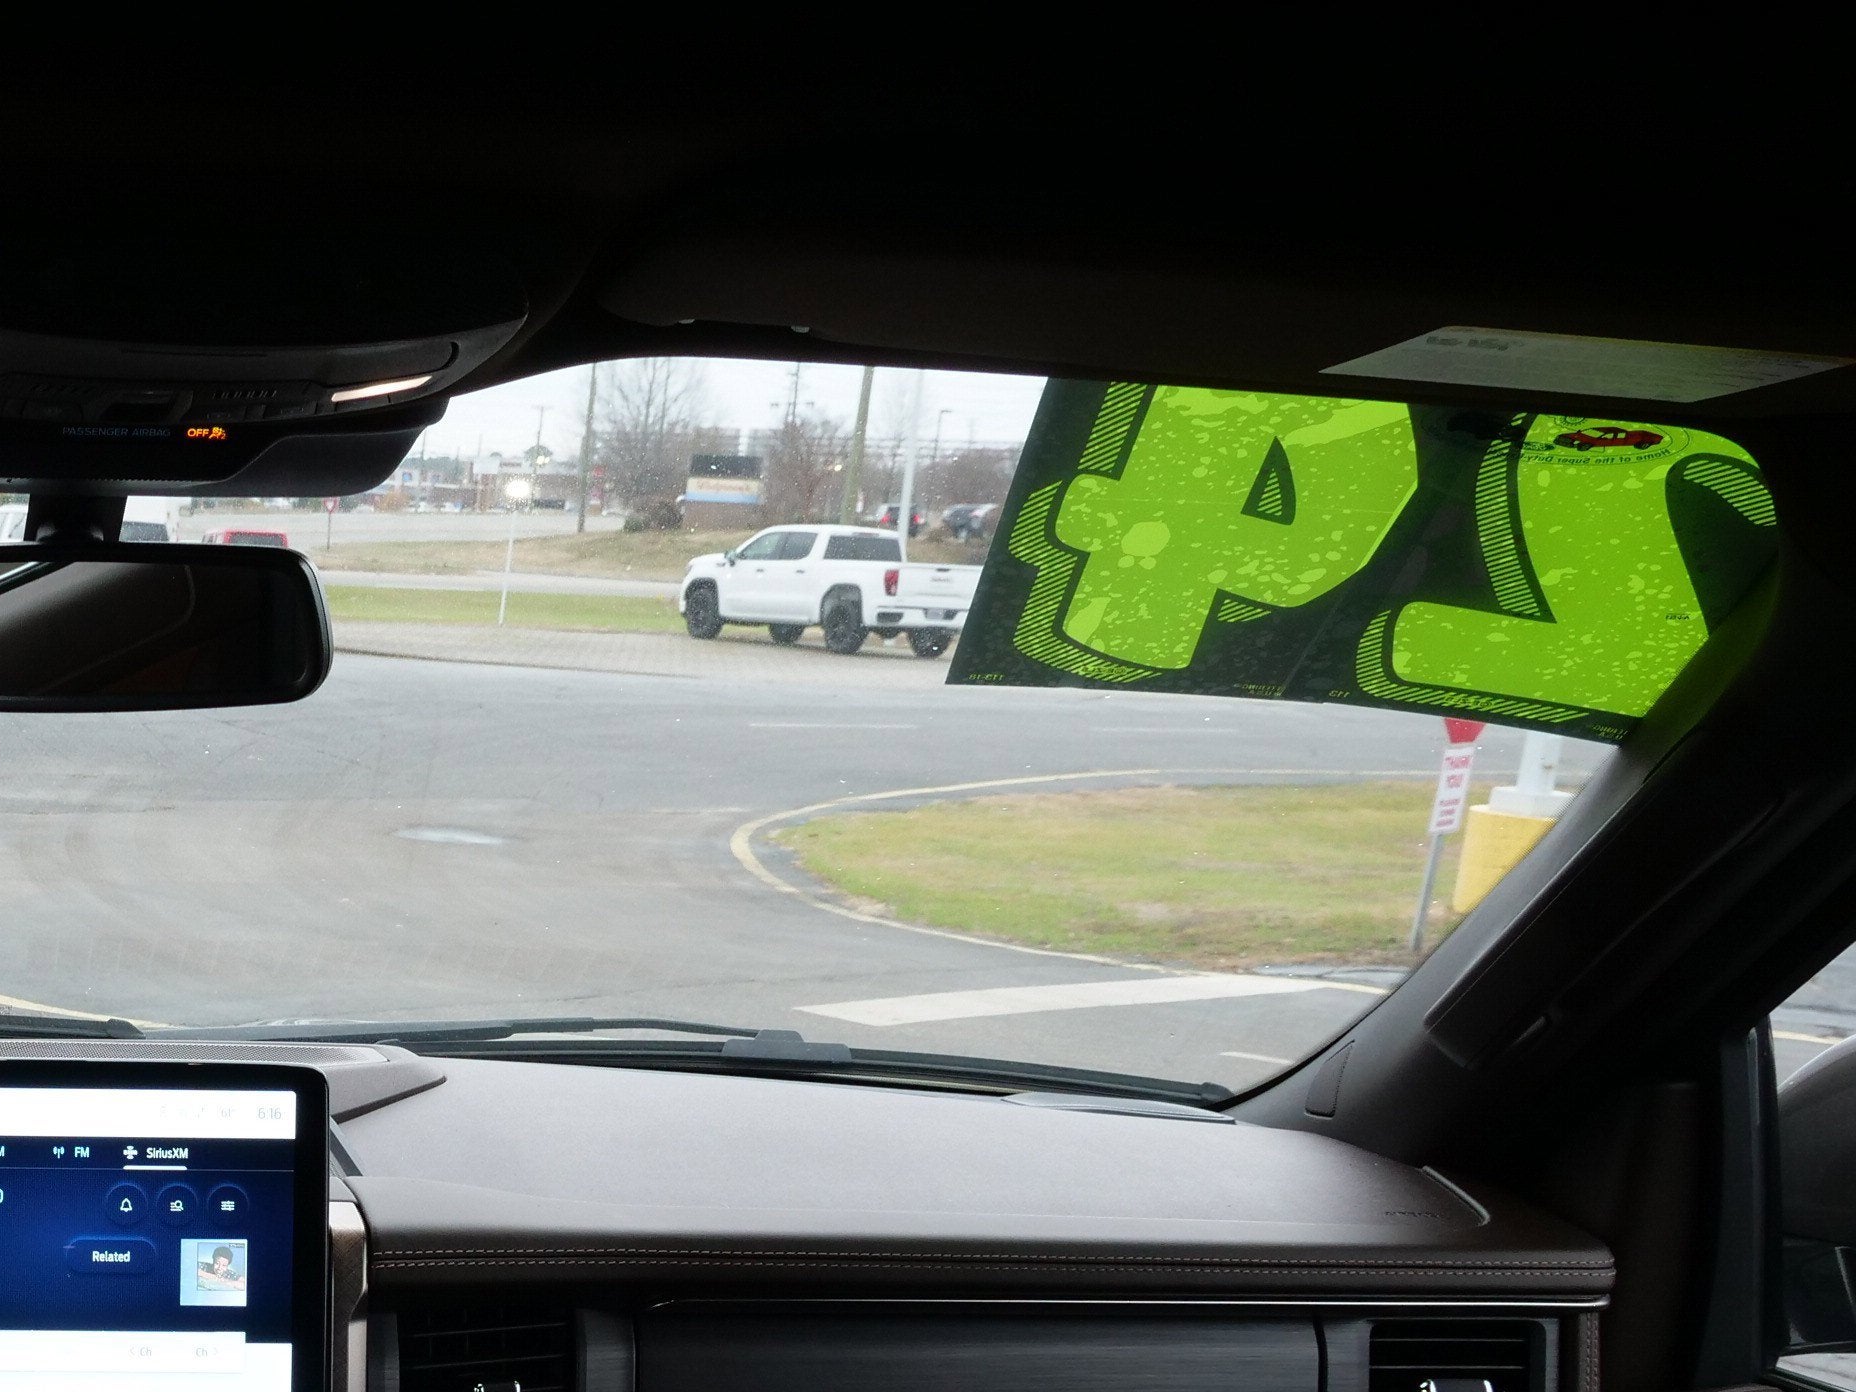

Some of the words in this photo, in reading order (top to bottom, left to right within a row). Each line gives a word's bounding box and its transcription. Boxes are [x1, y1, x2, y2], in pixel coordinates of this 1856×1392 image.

[62, 427, 129, 437] PASSENGER
[132, 428, 170, 437] AIRBAG
[186, 428, 210, 438] OFF
[74, 1147, 90, 1159] FM
[146, 1147, 189, 1160] SiriusXM
[91, 1249, 131, 1263] Related
